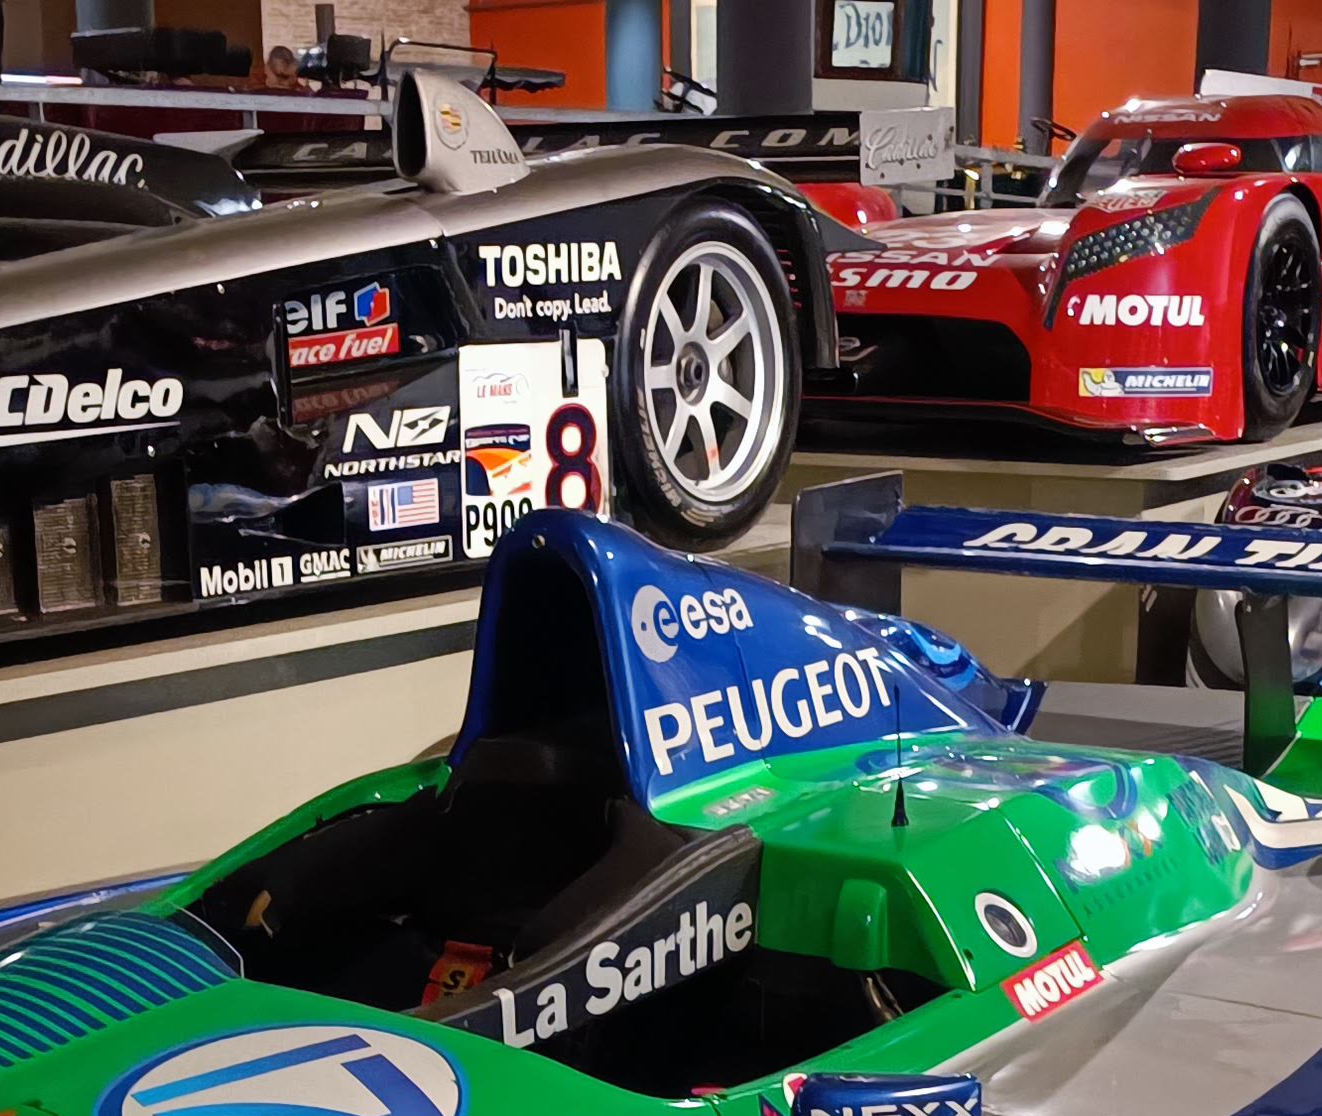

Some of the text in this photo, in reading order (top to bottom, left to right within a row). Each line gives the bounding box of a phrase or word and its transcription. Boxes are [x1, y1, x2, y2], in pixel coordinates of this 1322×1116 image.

[477, 241, 623, 288] TOSHIBA
[825, 250, 1002, 266] ISSAN
[284, 290, 347, 335] elf
[574, 289, 613, 315] Lead.
[1079, 294, 1206, 327] MOTUL
[290, 327, 394, 366] ace fuel
[1124, 374, 1210, 388] MICHELIN
[324, 449, 462, 479] NORTHSTAR
[545, 403, 603, 516] 8
[379, 540, 447, 563] MICHELIN
[964, 522, 1224, 561] GRAN
[200, 558, 269, 598] Mobil
[300, 548, 351, 575] GMAC
[679, 588, 755, 640] esa
[644, 646, 892, 776] PEUGEOT
[493, 900, 753, 1050] La Sarthe
[1013, 949, 1097, 1018] MOTUL
